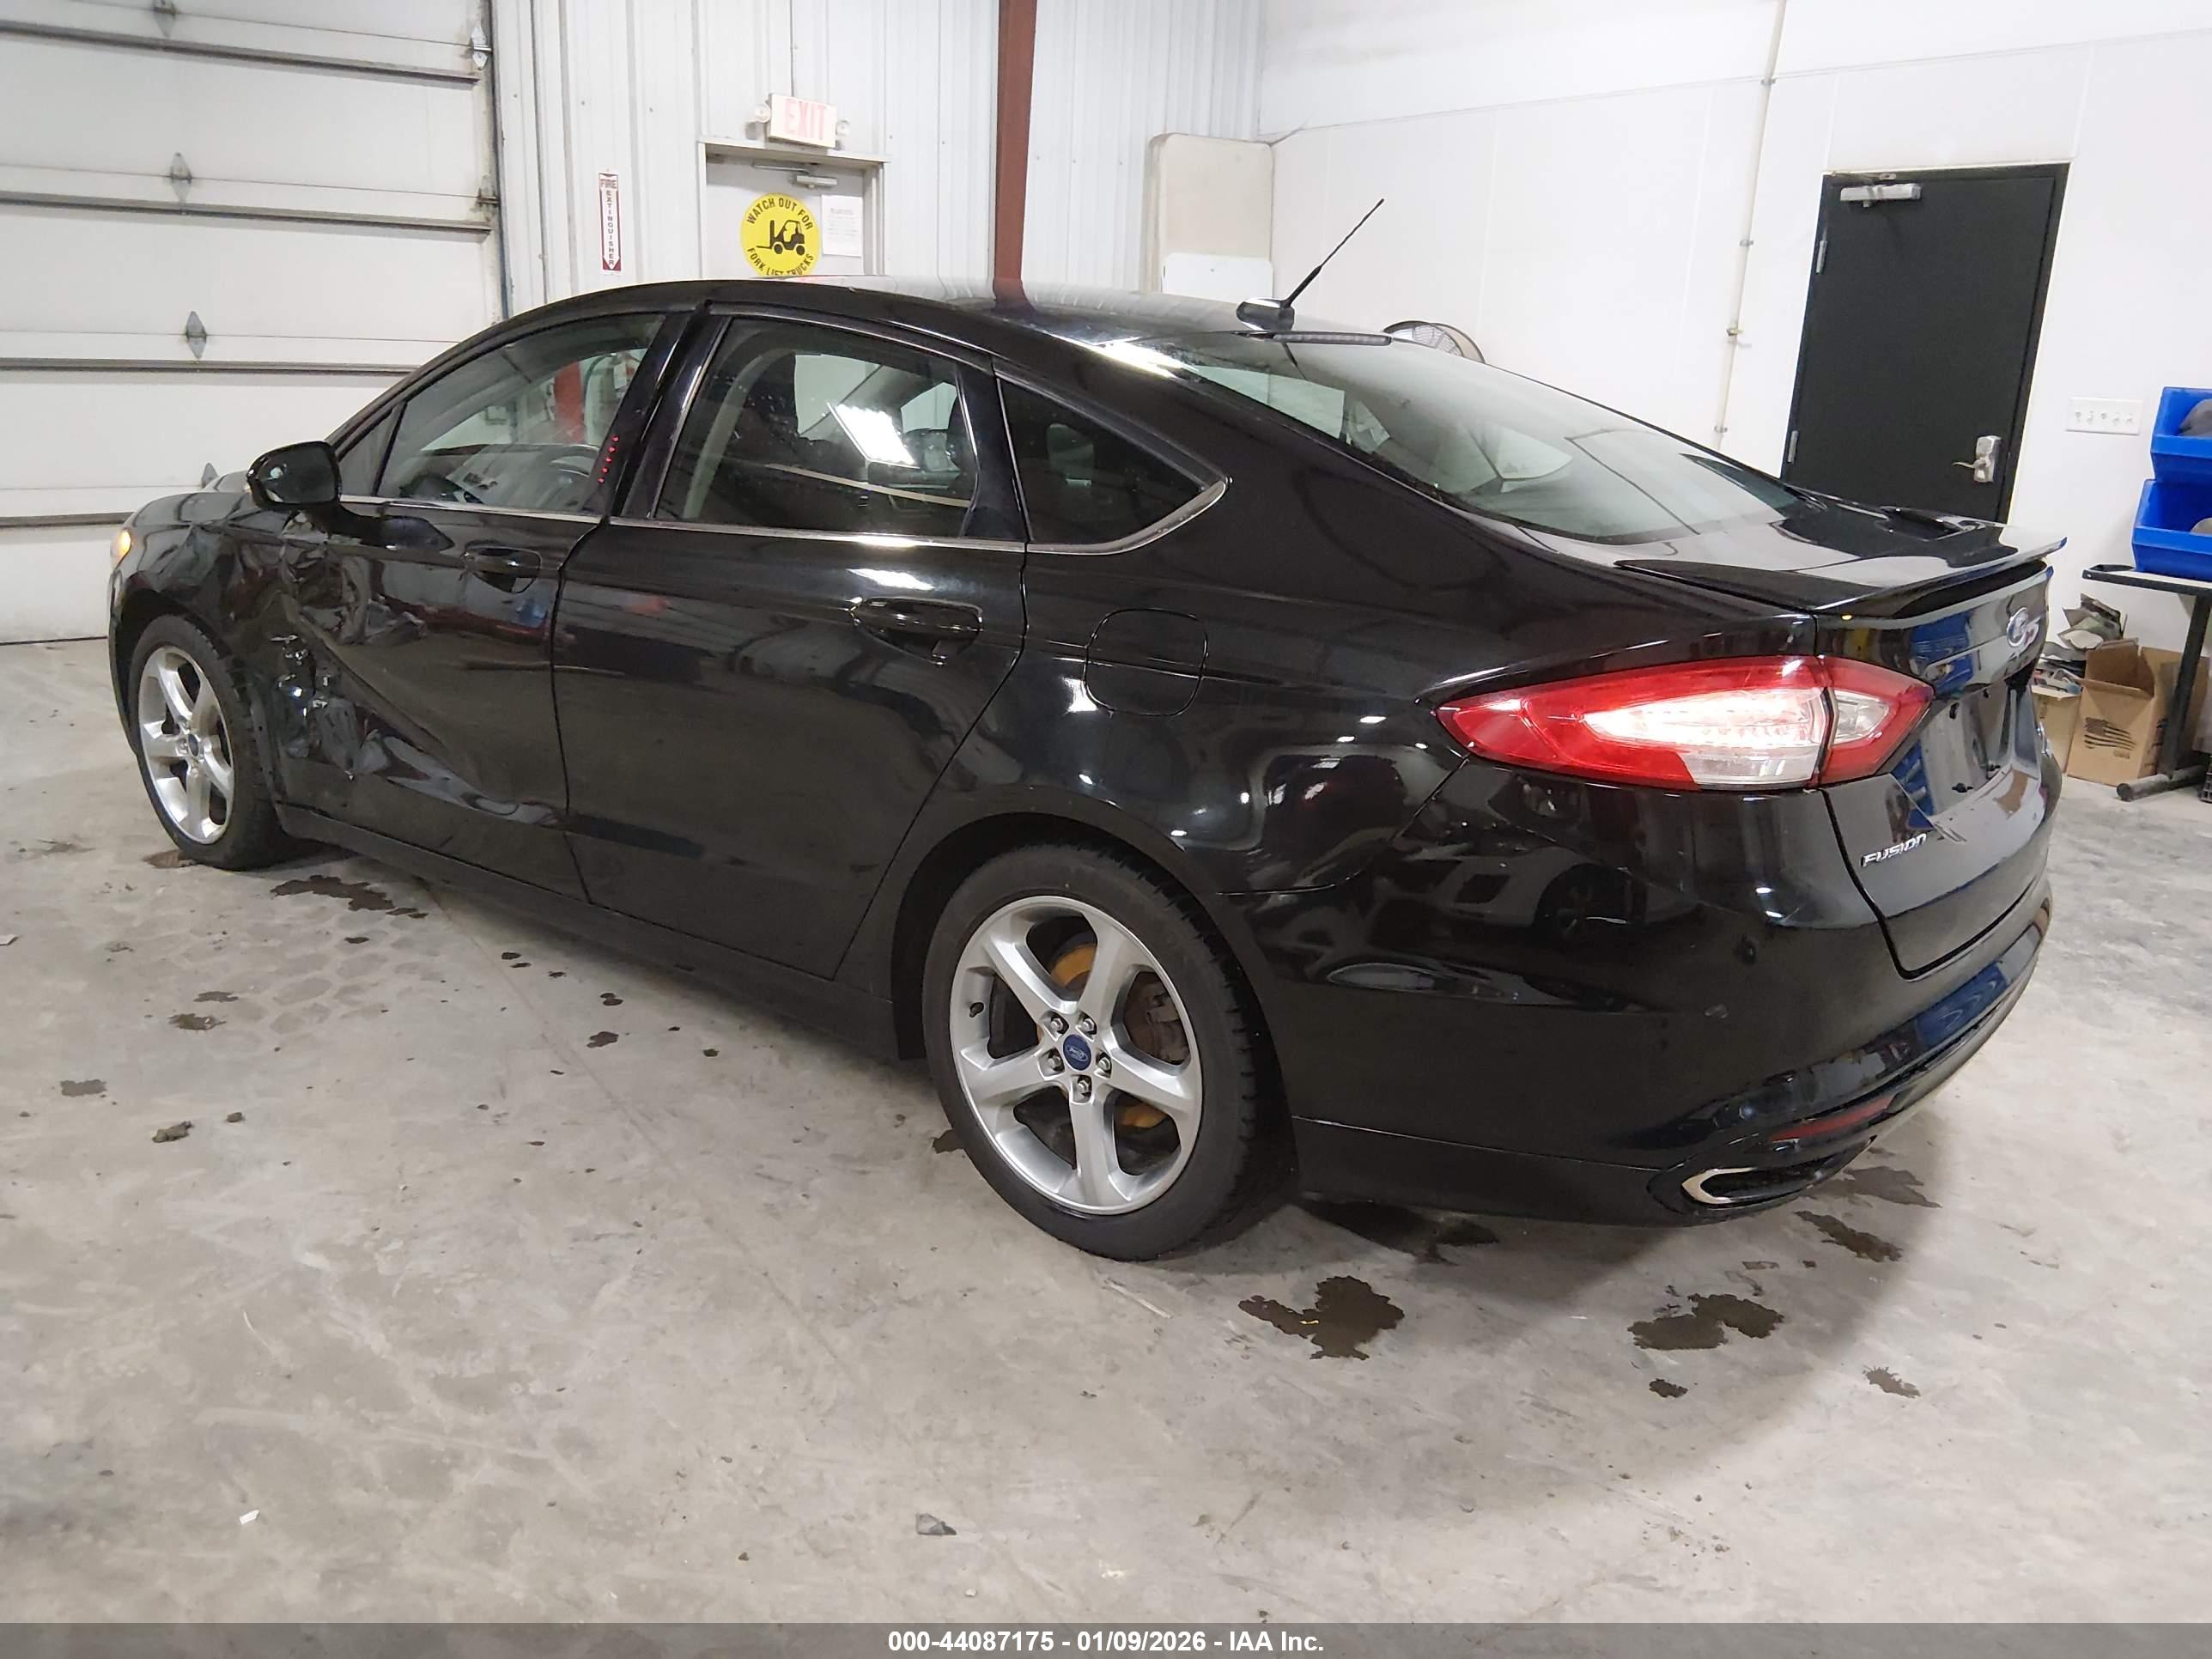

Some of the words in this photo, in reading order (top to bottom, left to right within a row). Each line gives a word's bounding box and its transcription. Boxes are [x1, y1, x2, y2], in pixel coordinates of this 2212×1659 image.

[783, 98, 828, 141] EXIT
[600, 179, 617, 189] FIRE
[605, 190, 615, 265] EXTINGUISHER
[746, 198, 775, 224] WATCH
[778, 198, 798, 211] OUT
[797, 209, 813, 230] FOR
[747, 247, 766, 271] FORK
[1861, 833, 1927, 867] FUSION
